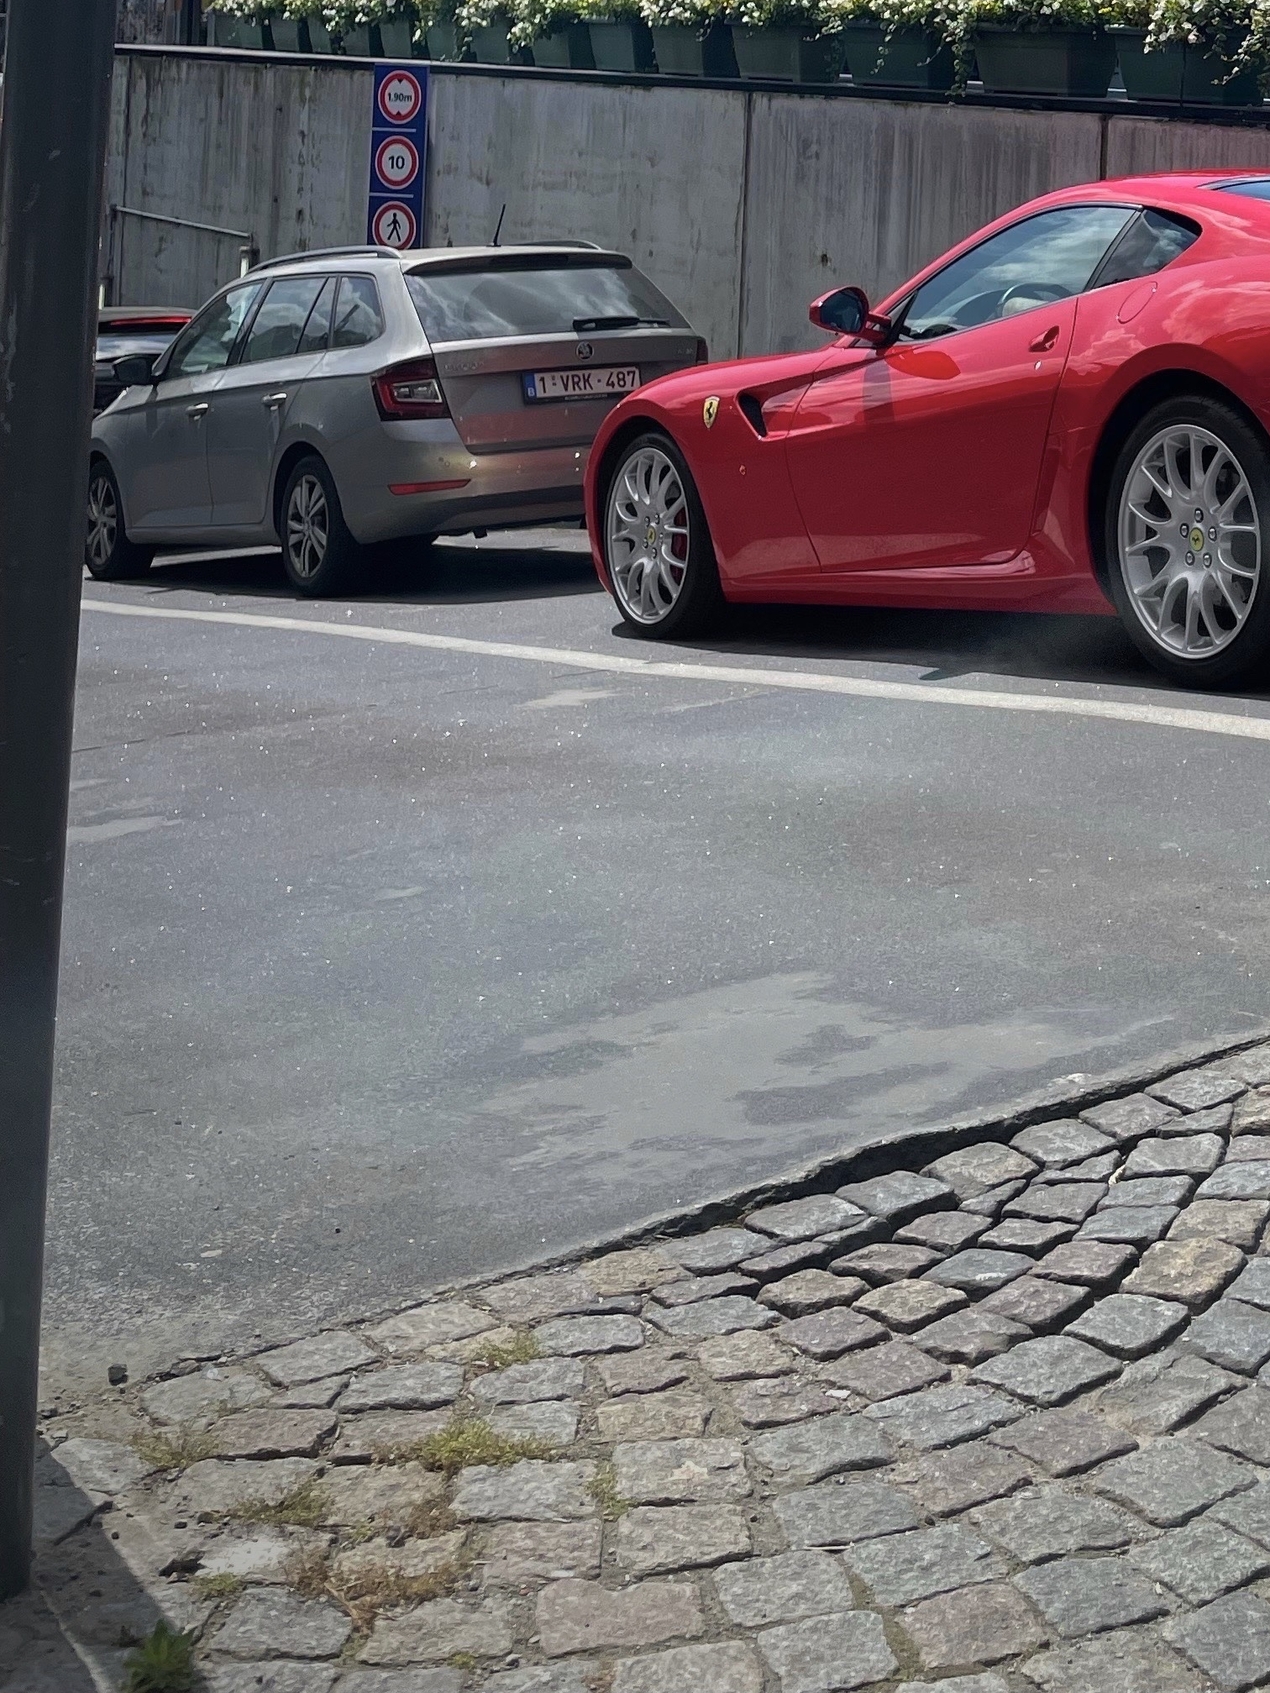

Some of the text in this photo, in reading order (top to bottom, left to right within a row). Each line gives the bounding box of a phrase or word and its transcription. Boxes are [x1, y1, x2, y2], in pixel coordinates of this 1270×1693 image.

[388, 92, 413, 103] 1.90m
[388, 155, 406, 171] 10
[527, 387, 536, 397] B
